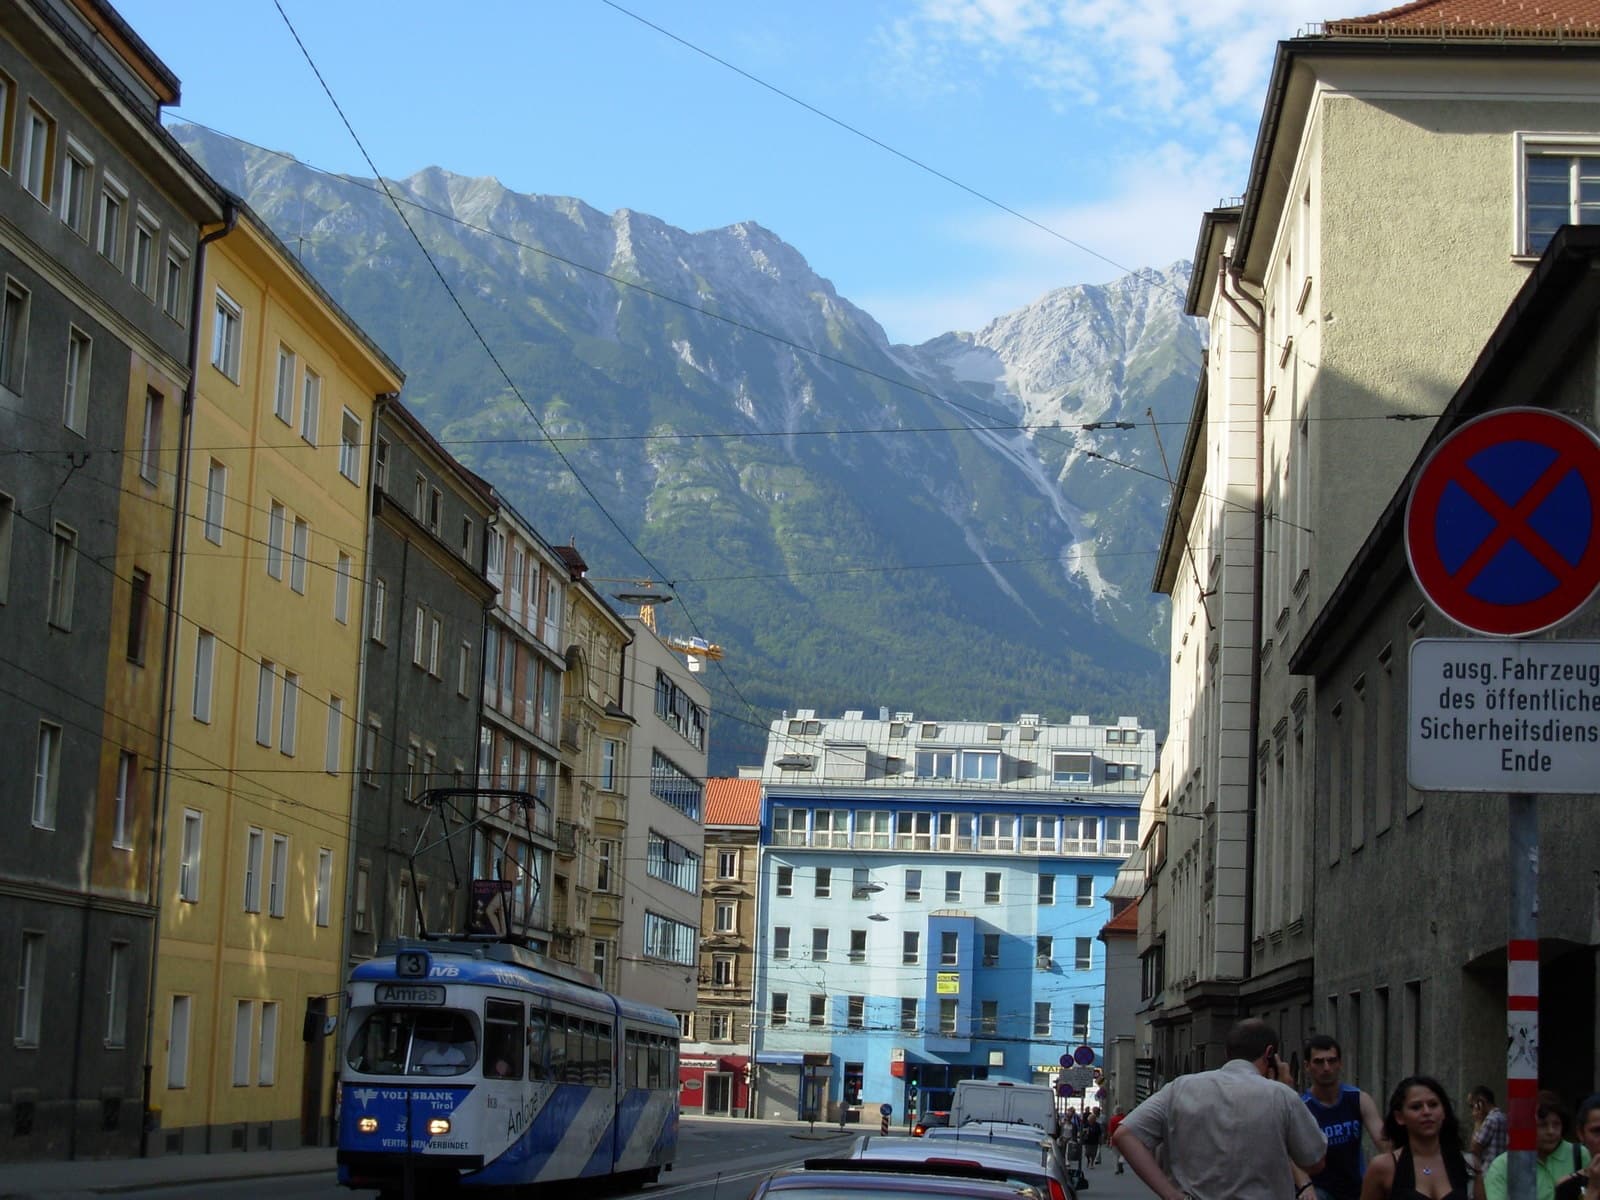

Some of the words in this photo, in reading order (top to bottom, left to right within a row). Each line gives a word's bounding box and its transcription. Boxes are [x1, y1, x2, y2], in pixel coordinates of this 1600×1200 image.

[1439, 686, 1475, 710] des
[1420, 716, 1599, 743] Sicherheitsdiens
[1501, 748, 1552, 772] Ende
[408, 955, 421, 972] 3
[429, 967, 459, 977] IVB
[383, 986, 437, 1001] Amras
[431, 1102, 454, 1110] Tirol
[1322, 1120, 1360, 1138] ORTS
[382, 1138, 427, 1148] VERTRUEN
[428, 1141, 469, 1150] VERBINDET
